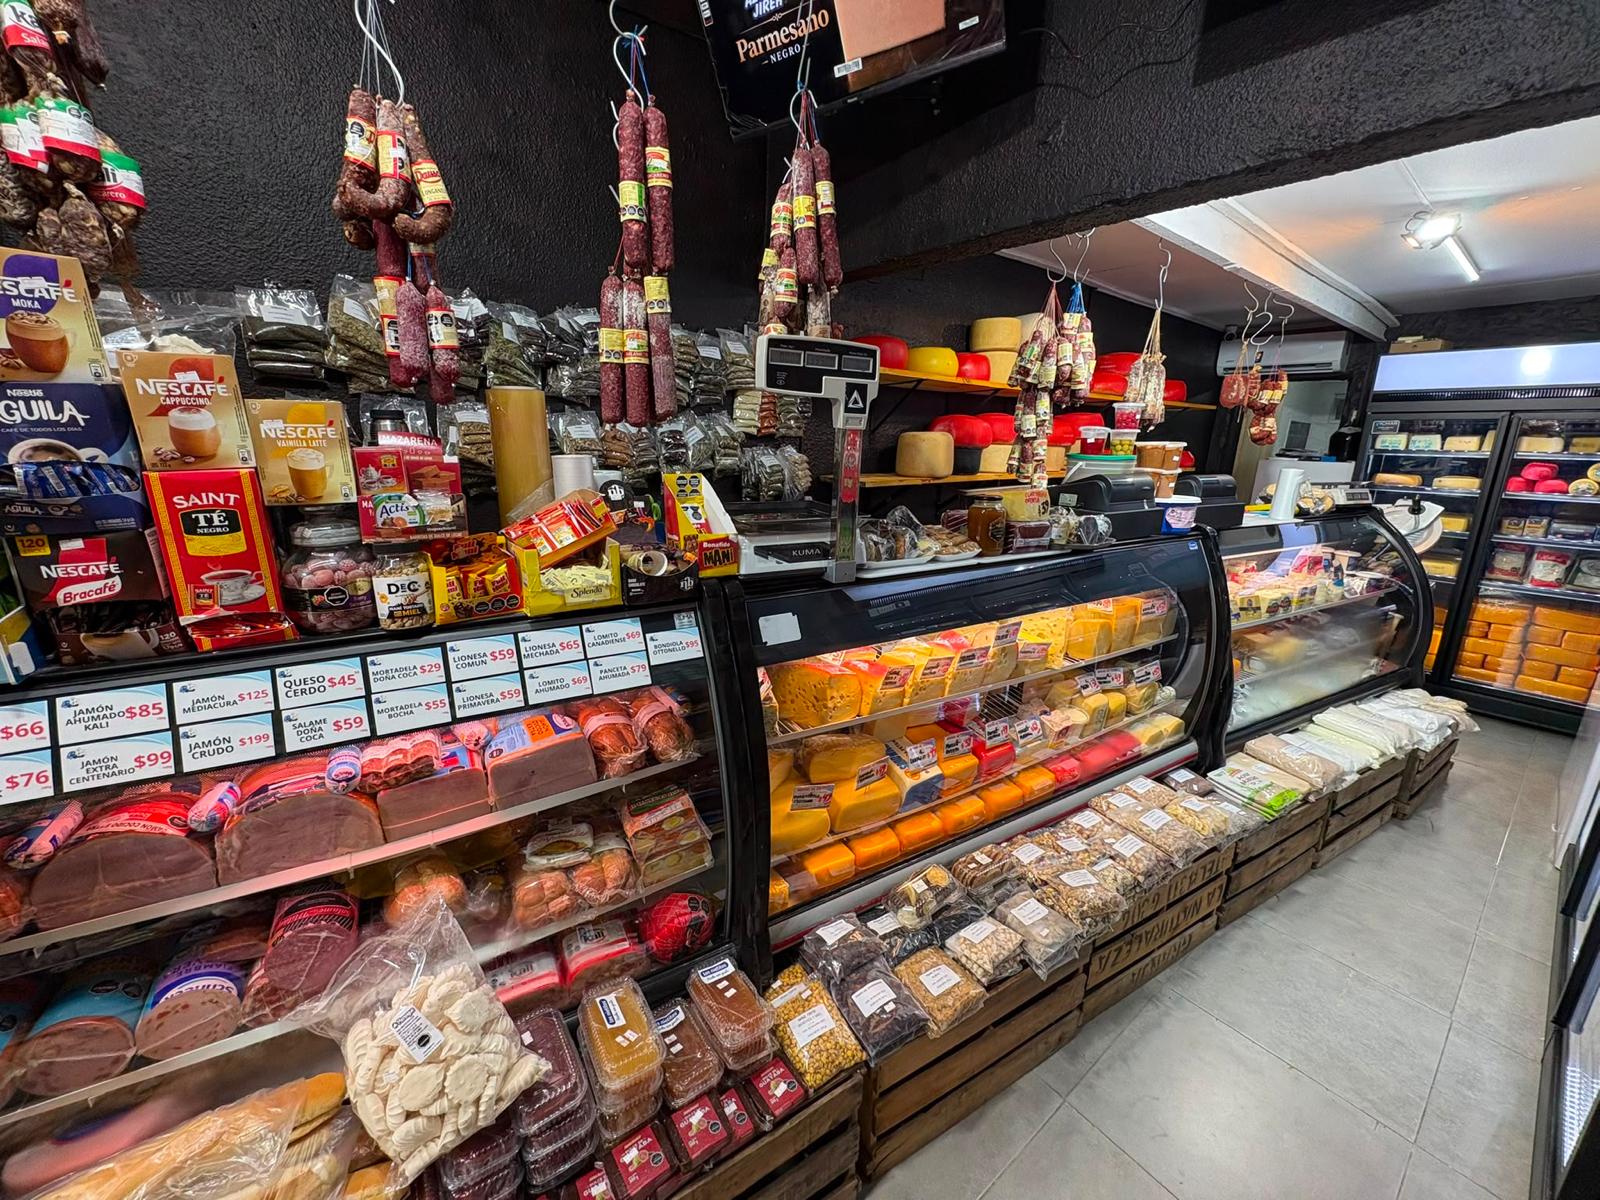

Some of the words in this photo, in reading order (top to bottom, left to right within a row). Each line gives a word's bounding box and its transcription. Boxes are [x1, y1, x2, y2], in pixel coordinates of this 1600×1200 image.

[736, 9, 829, 62] Parmesano
[770, 43, 800, 63] NEGRO
[11, 297, 41, 309] MOKA
[160, 397, 210, 406] CAPPUCCINO
[0, 400, 90, 426] GUILA
[276, 439, 307, 447] VAINILLA
[308, 439, 327, 447] LATTE
[172, 492, 240, 509] SAINT
[192, 510, 228, 527] TÉ
[197, 526, 230, 534] NEGRO
[20, 538, 45, 548] 120
[792, 548, 821, 557] KUMA
[63, 582, 117, 603] Bracafé
[587, 638, 626, 648] CANADIENSE
[625, 631, 641, 640] $69
[593, 632, 618, 641] LOMITO
[524, 642, 557, 653] LIONESA
[559, 640, 580, 651] $65
[653, 640, 683, 649] BONDIOLA
[685, 640, 699, 648] $95
[453, 652, 488, 663] LIONESA
[489, 648, 515, 662] $59
[523, 649, 560, 660] MECHADA
[372, 665, 418, 677] MORTADELA
[419, 663, 441, 674] $29
[456, 659, 487, 669] COMUN
[600, 665, 627, 674] PANCETA
[630, 664, 647, 674] $79
[284, 675, 325, 689] QUESO
[327, 674, 357, 689] $45
[398, 671, 418, 680] COCA
[538, 678, 565, 687] LOMITO
[571, 676, 588, 686] $69
[599, 671, 630, 681] AHUMADA
[285, 686, 326, 698] CERDO
[462, 692, 494, 703] LIONESA
[500, 688, 521, 700] $59
[535, 683, 570, 694] AHUMADO
[192, 694, 225, 706] JAMÓN
[238, 689, 269, 702] $125
[457, 697, 500, 711] PRIMAVERA
[73, 704, 113, 718] JAMÓN
[125, 702, 163, 720] $85
[182, 700, 238, 714] MEDIACURA
[377, 702, 423, 715] MORTADELA
[424, 699, 447, 711] $55
[66, 711, 125, 726] AHUMADO
[388, 710, 414, 719] BOCHA
[0, 721, 44, 740] $66
[84, 721, 109, 731] KALI
[292, 717, 327, 730] SALAME
[333, 716, 363, 732] $59
[188, 736, 231, 753] JAMÓN
[239, 733, 270, 747] $199
[300, 733, 324, 743] COCA
[192, 745, 234, 760] CRUDO
[80, 756, 118, 769] JAMÓN
[134, 751, 172, 769] $99
[86, 763, 118, 774] EXTRA
[6, 770, 49, 790] $76
[70, 768, 135, 785] CENTENARIO
